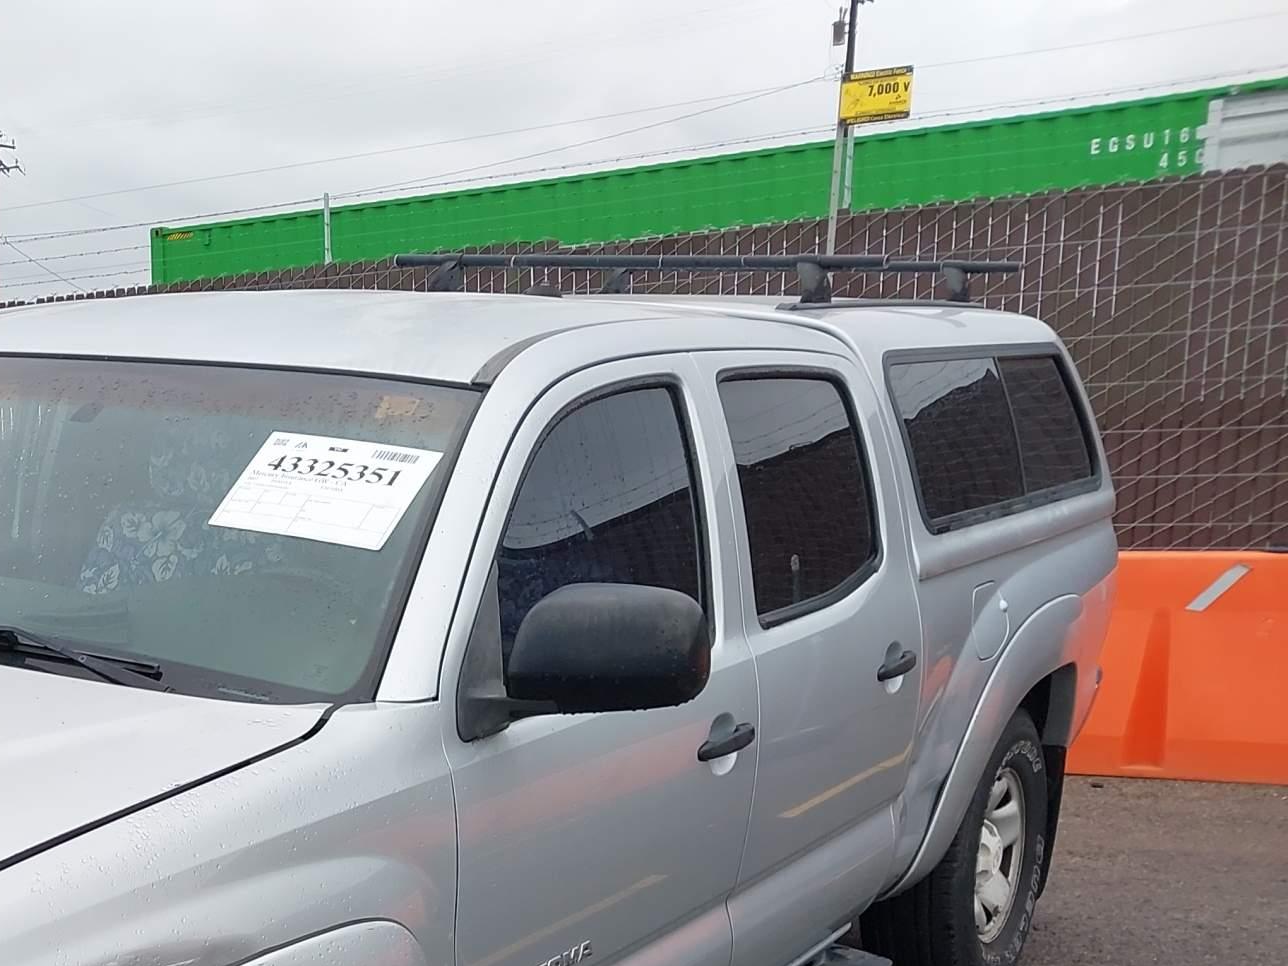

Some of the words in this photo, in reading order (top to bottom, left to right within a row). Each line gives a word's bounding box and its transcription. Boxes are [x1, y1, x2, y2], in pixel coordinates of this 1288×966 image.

[868, 82, 899, 98] 7,000
[903, 82, 911, 92] V
[268, 454, 403, 487] 43325351
